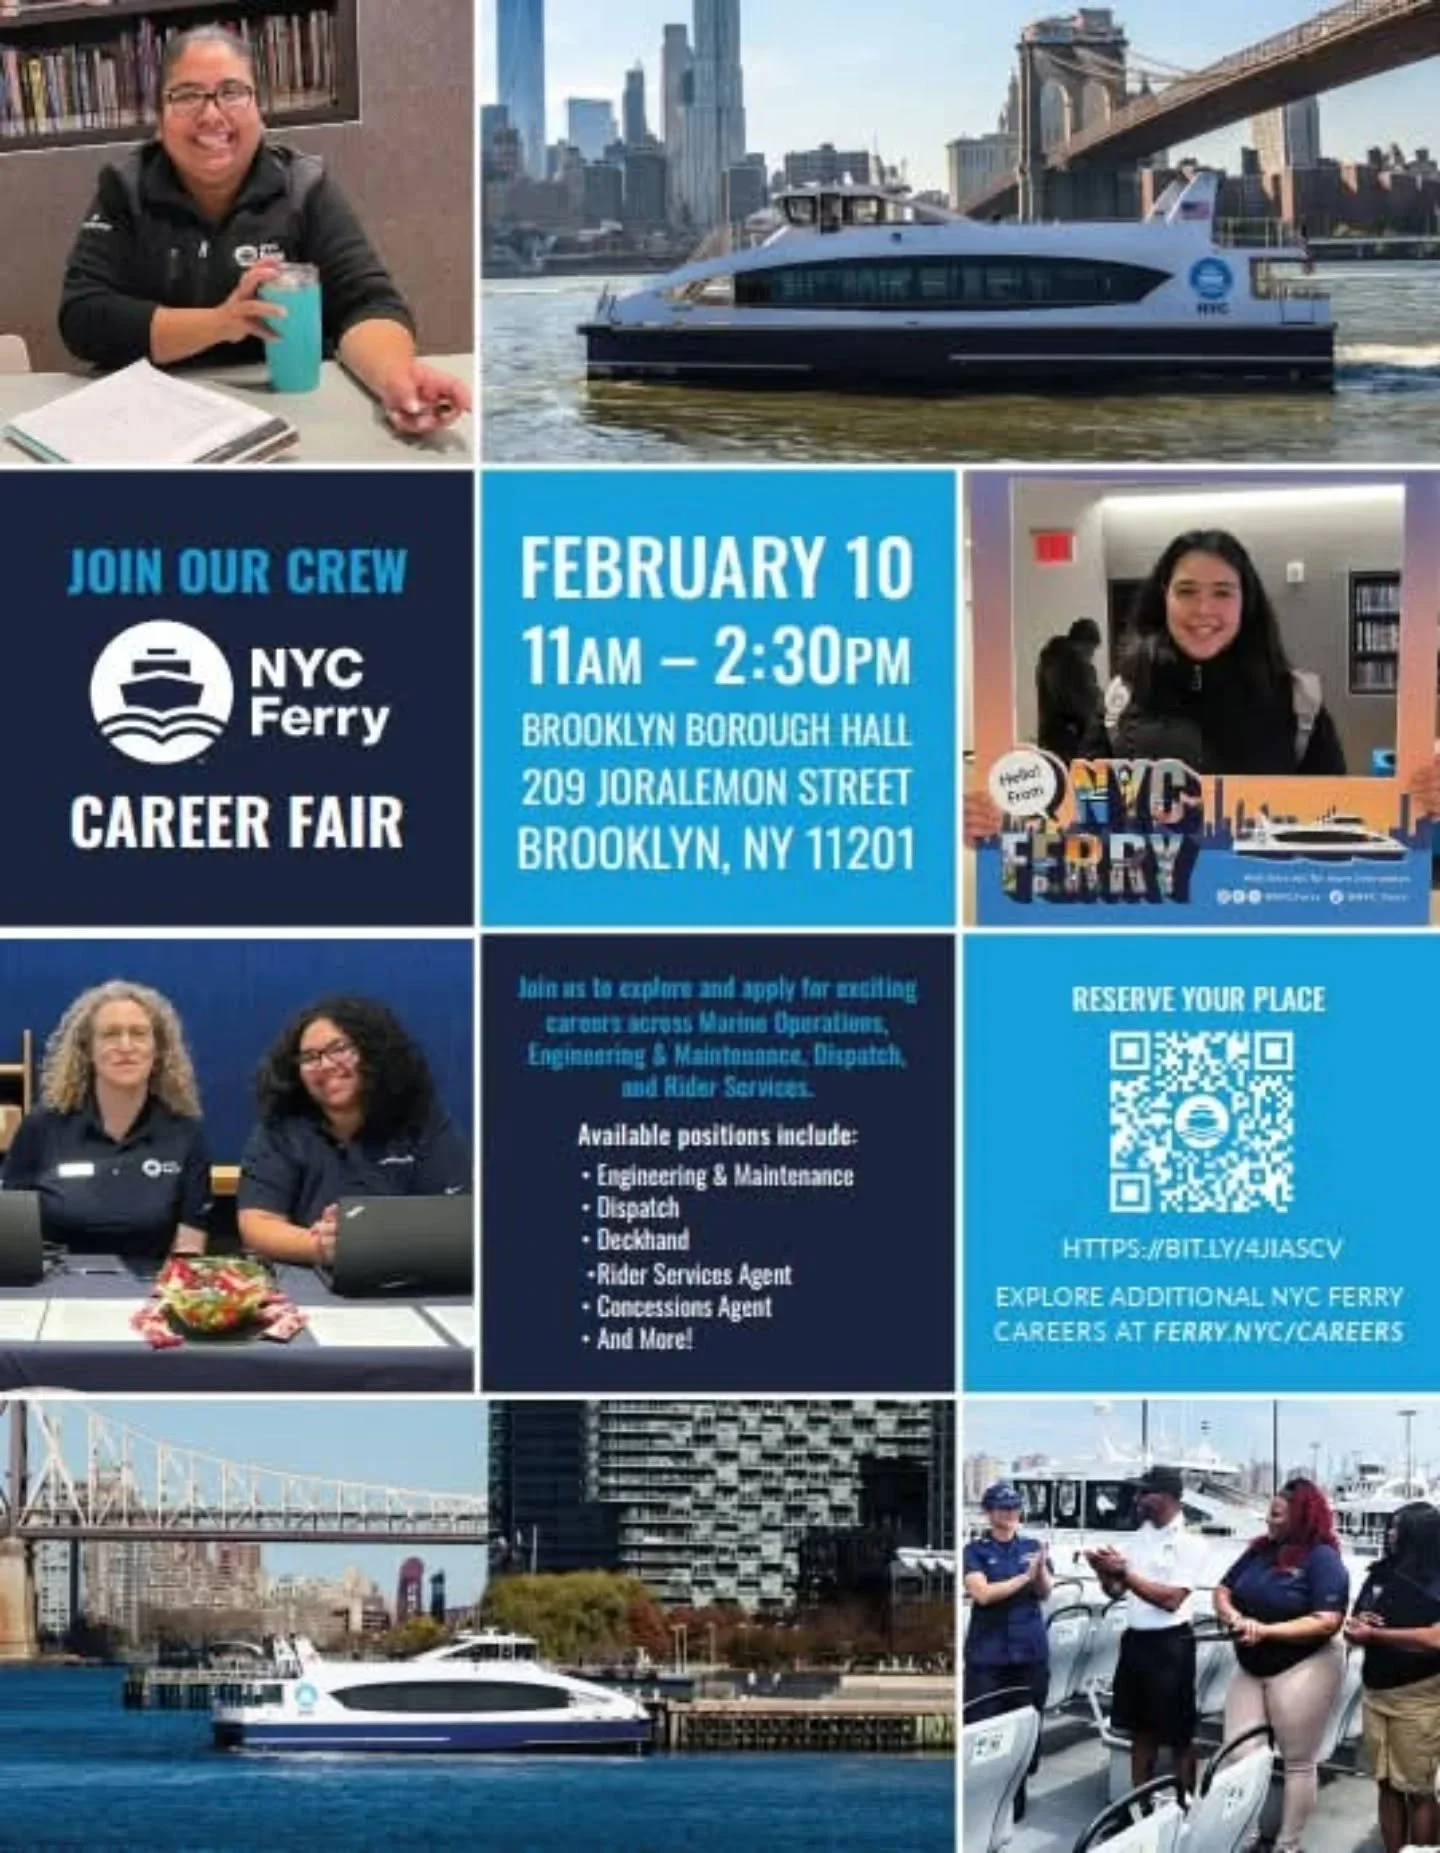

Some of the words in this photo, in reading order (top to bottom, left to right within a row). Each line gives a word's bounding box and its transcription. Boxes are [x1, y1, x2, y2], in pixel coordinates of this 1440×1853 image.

[68, 548, 162, 594] JOIN
[179, 548, 269, 594] OUR
[287, 548, 407, 594] CREW
[522, 535, 827, 601] FEBRUARY
[846, 535, 913, 601] 10
[250, 646, 364, 690] NYC
[522, 624, 642, 686] 11AM
[714, 624, 911, 686] 2:30PM
[250, 695, 391, 747] Ferry
[522, 712, 676, 747] BROOKLYN
[685, 712, 830, 747] BOROUGH
[841, 713, 912, 747] HALL
[522, 768, 586, 806] 209
[597, 767, 787, 807] JORALEMON
[798, 767, 913, 806] STREET
[1071, 758, 1204, 827] NYC
[70, 794, 271, 850] CAREER
[288, 794, 404, 849] FAIR
[517, 825, 731, 875] BROOKLYN,
[744, 826, 794, 870] NY
[807, 826, 913, 871] 11201
[1000, 831, 1194, 904] FERRY
[519, 978, 558, 998] Join
[563, 983, 585, 998] us
[593, 978, 613, 998] to
[618, 977, 692, 1002] explore
[699, 977, 735, 998] and
[742, 977, 795, 1003] apply
[802, 978, 829, 998] for
[836, 978, 916, 1003] exciting
[1073, 986, 1174, 1012] RESERVE
[1182, 986, 1245, 1012] YOUR
[1254, 986, 1325, 1012] PLACE
[546, 1016, 621, 1033] careers
[628, 1017, 693, 1034] across
[699, 1011, 768, 1033] Marine
[774, 1011, 888, 1038] Operations,
[528, 1043, 645, 1070] Engineering
[653, 1043, 667, 1066] &
[622, 1078, 658, 1098] and
[664, 1075, 716, 1097] Rider
[724, 1075, 815, 1098] Services.
[577, 1122, 672, 1147] Available
[677, 1123, 771, 1152] positions
[776, 1122, 859, 1147] include:
[596, 1162, 708, 1192] Engineering
[712, 1162, 728, 1187] &
[733, 1162, 855, 1187] Maintenance
[596, 1195, 680, 1224] Dispatch
[596, 1227, 691, 1251] Deckhand
[653, 1261, 734, 1286] Services
[737, 1262, 793, 1291] Agent
[596, 1293, 714, 1319] Concessions
[717, 1294, 773, 1323] Agent
[996, 1286, 1104, 1309] EXPLORE
[1109, 1286, 1265, 1308] ADDITIONAL
[1271, 1286, 1320, 1308] NYC
[1328, 1286, 1404, 1308] FERRY
[596, 1326, 634, 1350] And
[639, 1326, 693, 1351] More!
[994, 1320, 1107, 1342] CAREERS
[1115, 1320, 1147, 1342] AT
[1153, 1320, 1404, 1343] FERRY.NYC/CAREERS
